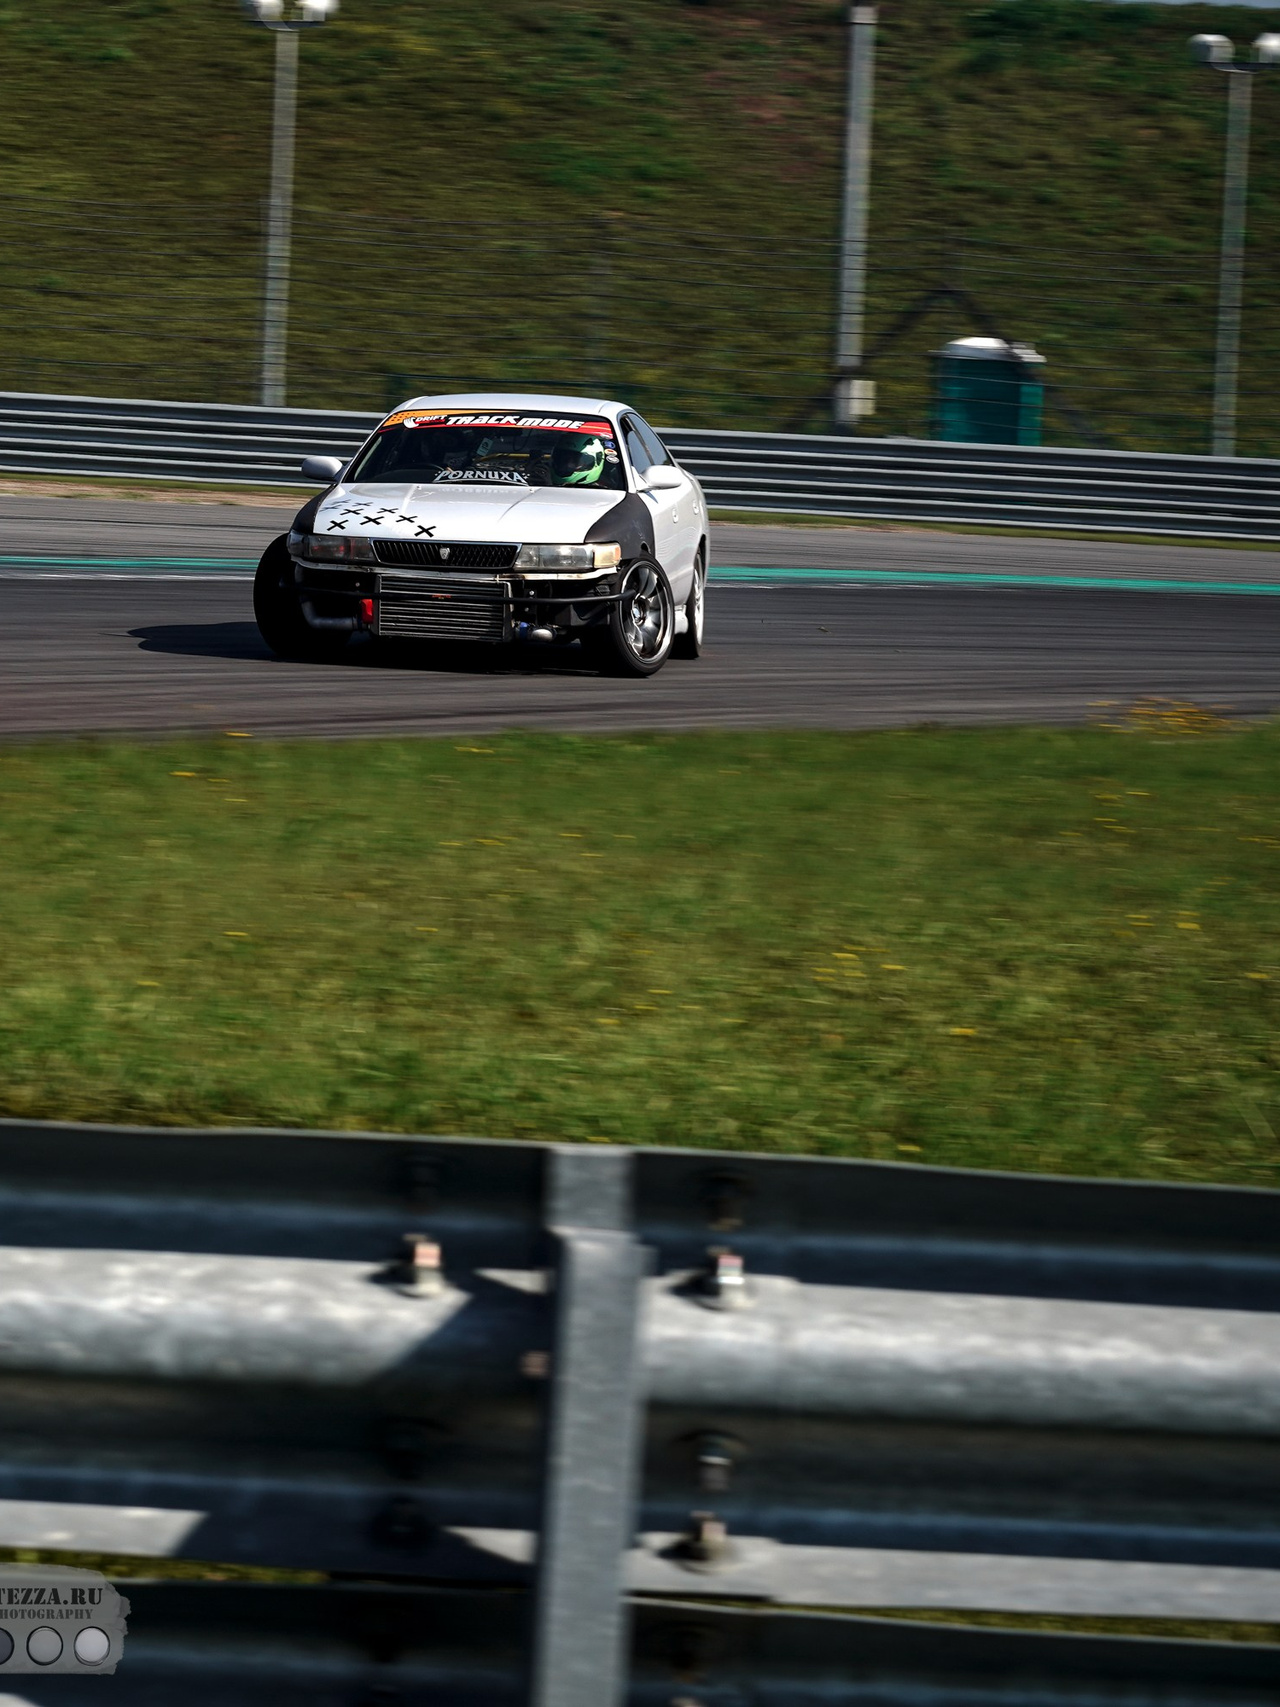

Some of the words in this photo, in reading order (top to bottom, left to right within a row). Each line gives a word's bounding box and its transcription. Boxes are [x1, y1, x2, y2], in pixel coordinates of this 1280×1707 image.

[415, 414, 448, 422] DRIFT
[446, 415, 522, 426] TRACK
[517, 417, 585, 430] MODE
[433, 469, 528, 485] PORNUXA
